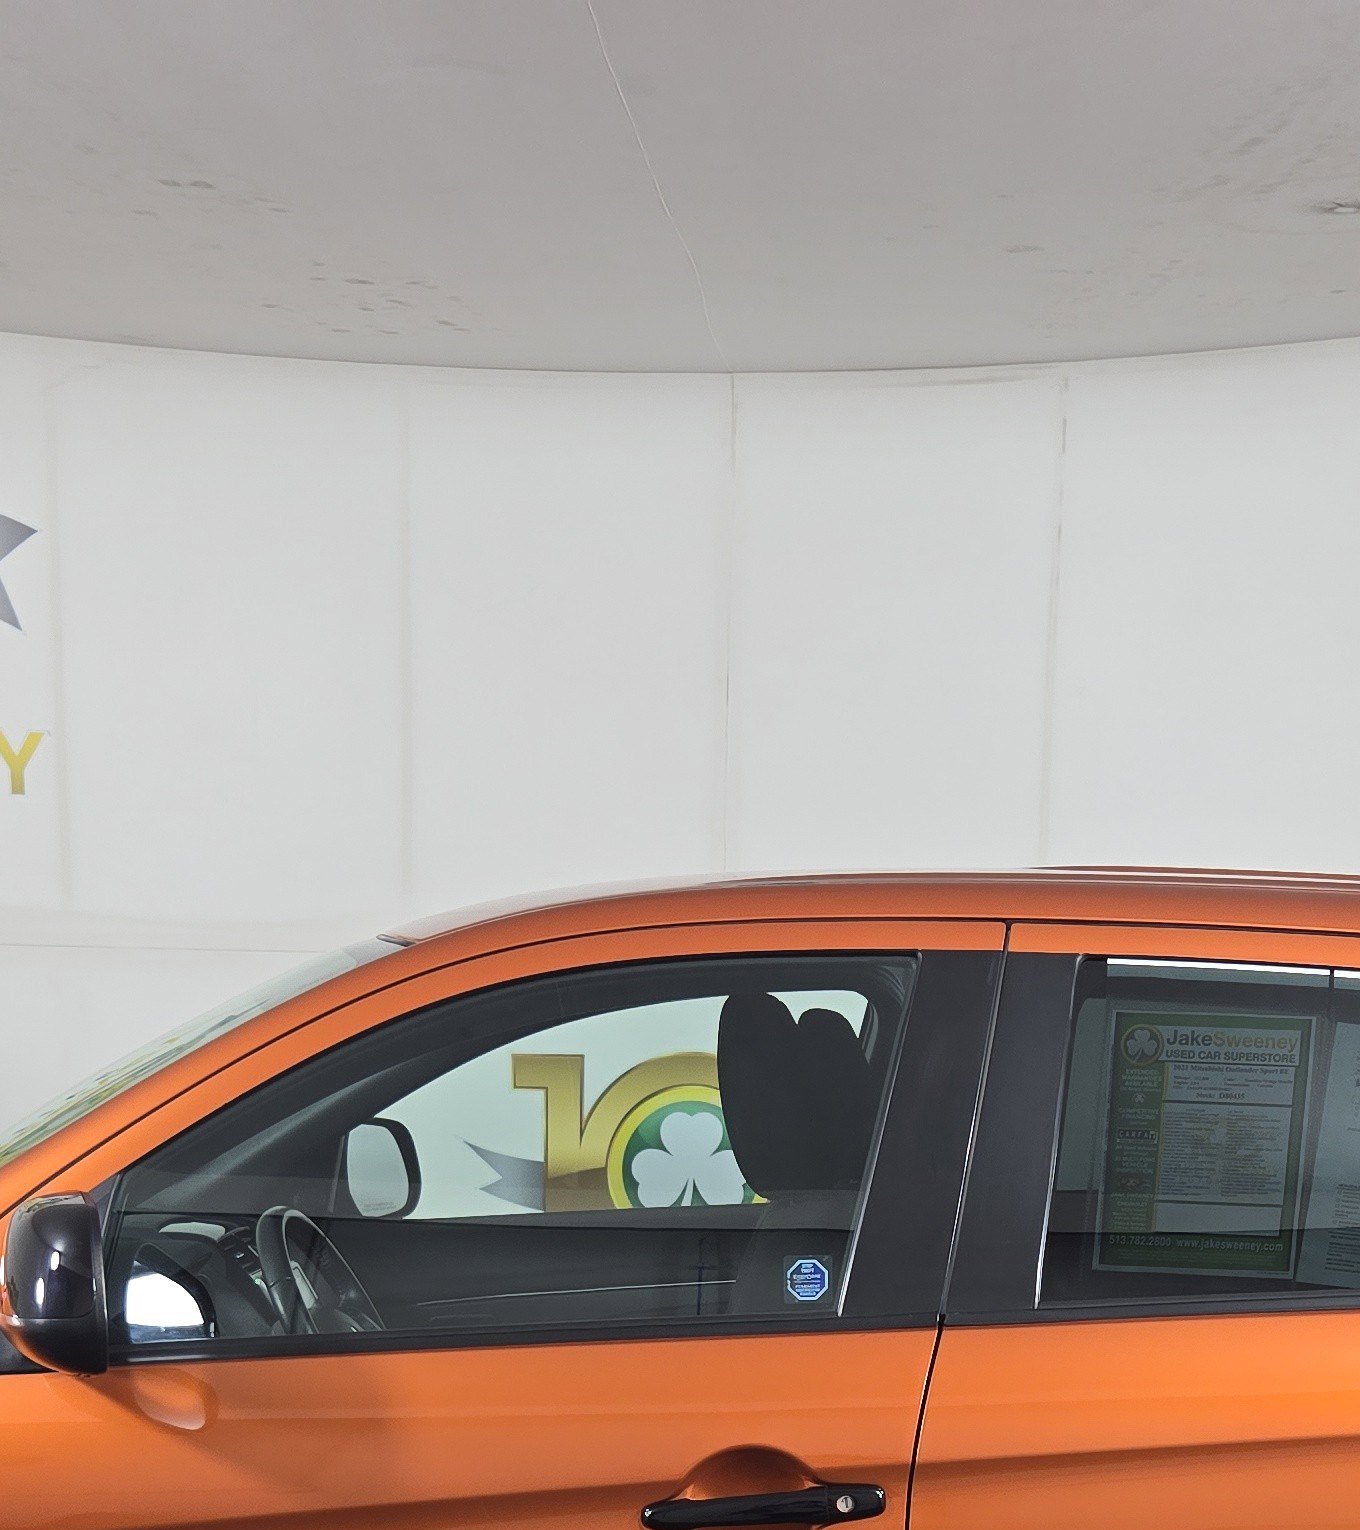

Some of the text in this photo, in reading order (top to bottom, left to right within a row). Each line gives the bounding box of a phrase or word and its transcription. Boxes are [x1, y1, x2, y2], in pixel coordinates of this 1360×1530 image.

[1166, 1029, 1298, 1054] JakeSweeney
[1165, 1049, 1296, 1064] USED CAR SUPERSTORE
[1176, 1238, 1284, 1253] www.jakesweeney.com
